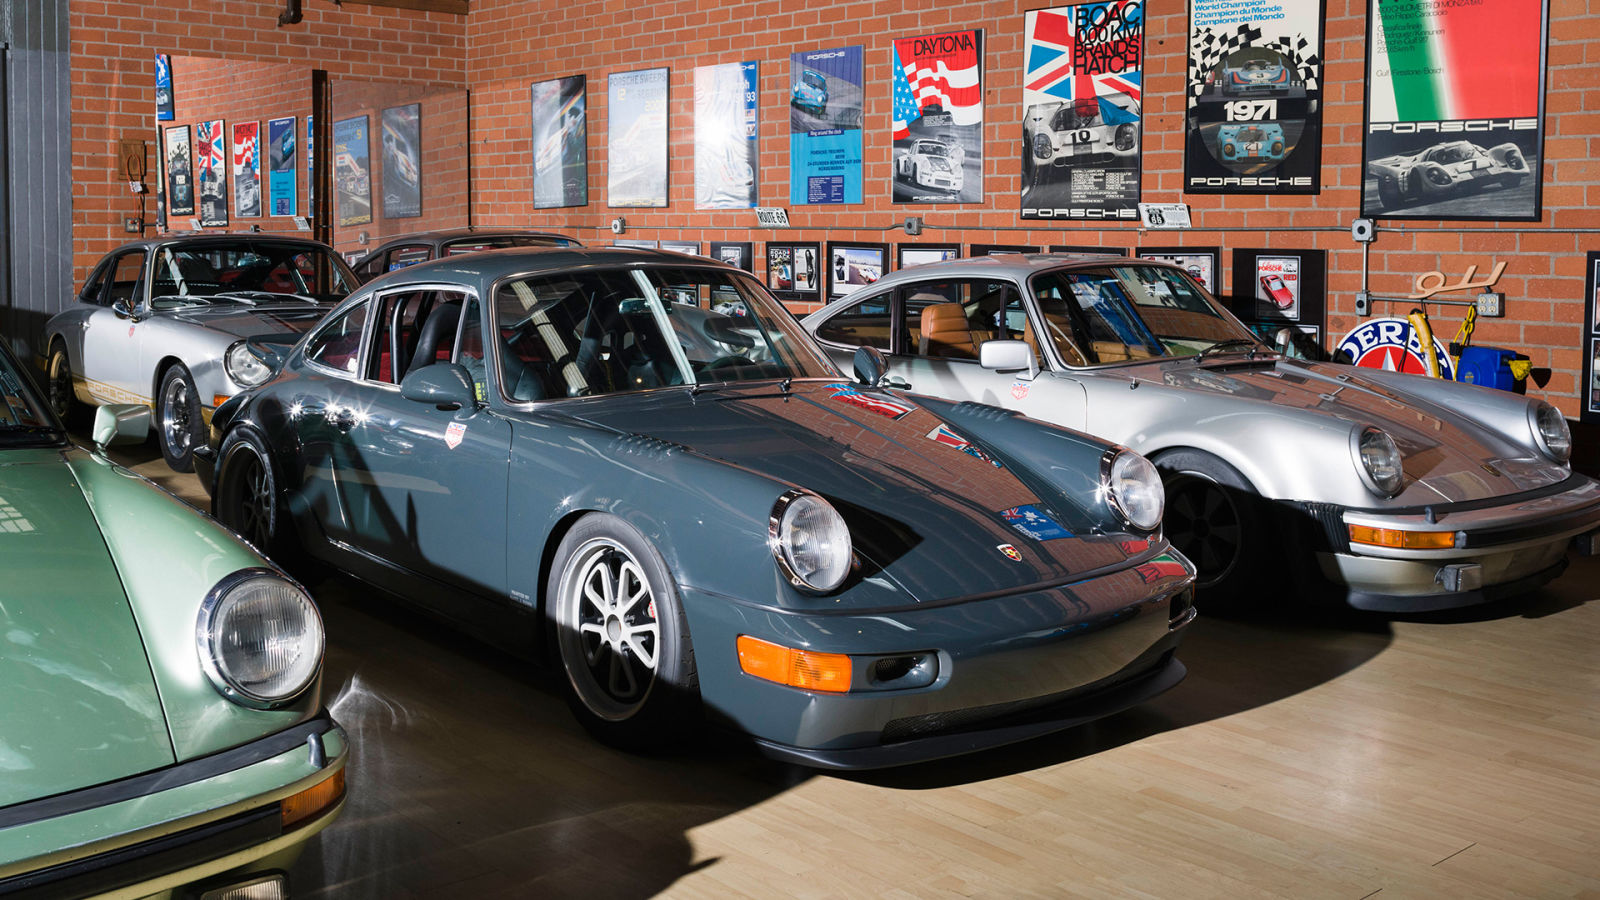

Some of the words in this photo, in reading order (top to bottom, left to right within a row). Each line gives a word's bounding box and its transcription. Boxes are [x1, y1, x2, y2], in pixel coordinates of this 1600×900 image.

[1194, 3, 1220, 12] World
[1220, 0, 1266, 10] Champion
[1194, 10, 1239, 19] Champion
[1239, 7, 1251, 15] du
[1251, 5, 1283, 14] Monde
[1076, 2, 1140, 28] BOAC
[1194, 17, 1239, 27] Campione
[1239, 15, 1252, 23] del
[1253, 13, 1285, 21] Mondo
[1110, 23, 1140, 42] KM
[914, 34, 975, 56] DAYTONA
[1075, 39, 1140, 58] BRANDS
[807, 51, 846, 61] PORSCHE
[1073, 54, 1140, 76] HATCH
[1224, 99, 1277, 122] 1971
[1369, 119, 1537, 134] PORSCHE
[1070, 130, 1091, 146] 10
[1190, 177, 1312, 186] PORSCHE
[757, 211, 777, 224] ROUTE
[776, 211, 787, 224] 66
[1022, 208, 1137, 218] PORSCHE
